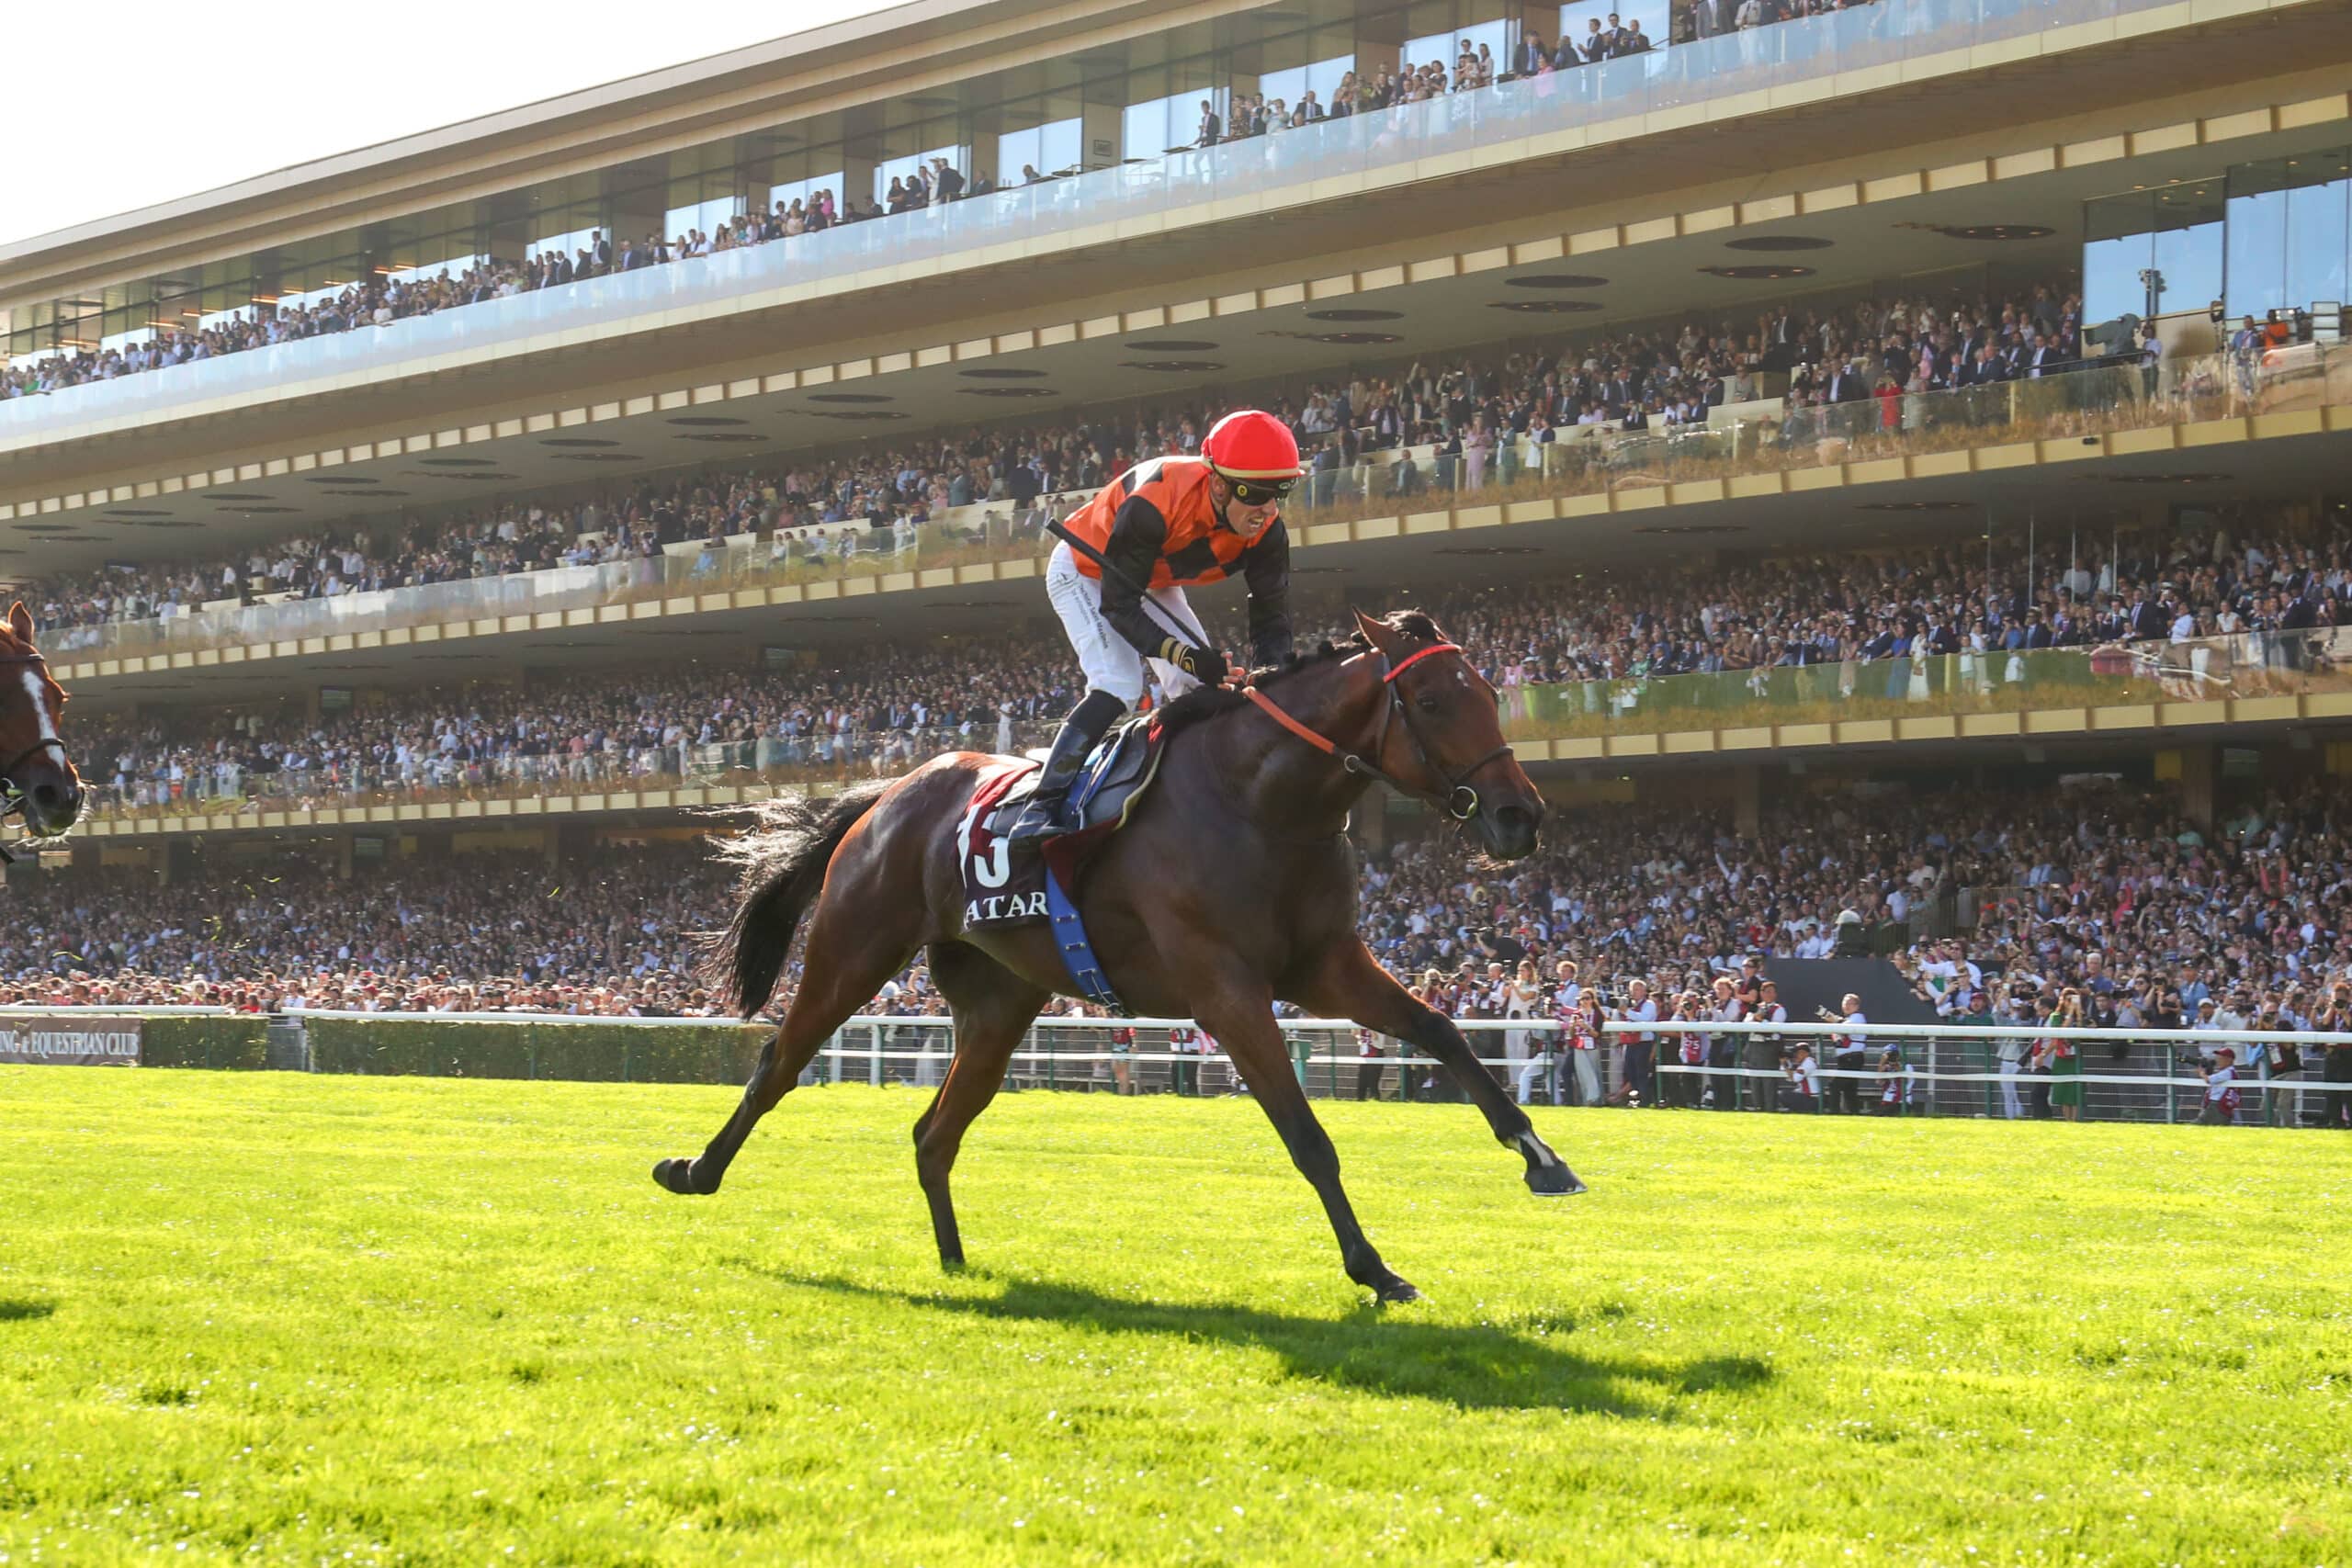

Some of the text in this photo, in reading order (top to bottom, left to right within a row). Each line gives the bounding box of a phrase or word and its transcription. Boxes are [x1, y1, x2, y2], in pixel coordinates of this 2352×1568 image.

[963, 891, 1049, 930] ATAR
[30, 1031, 106, 1058] EQUESTRIAN
[106, 1032, 139, 1055] CLUB
